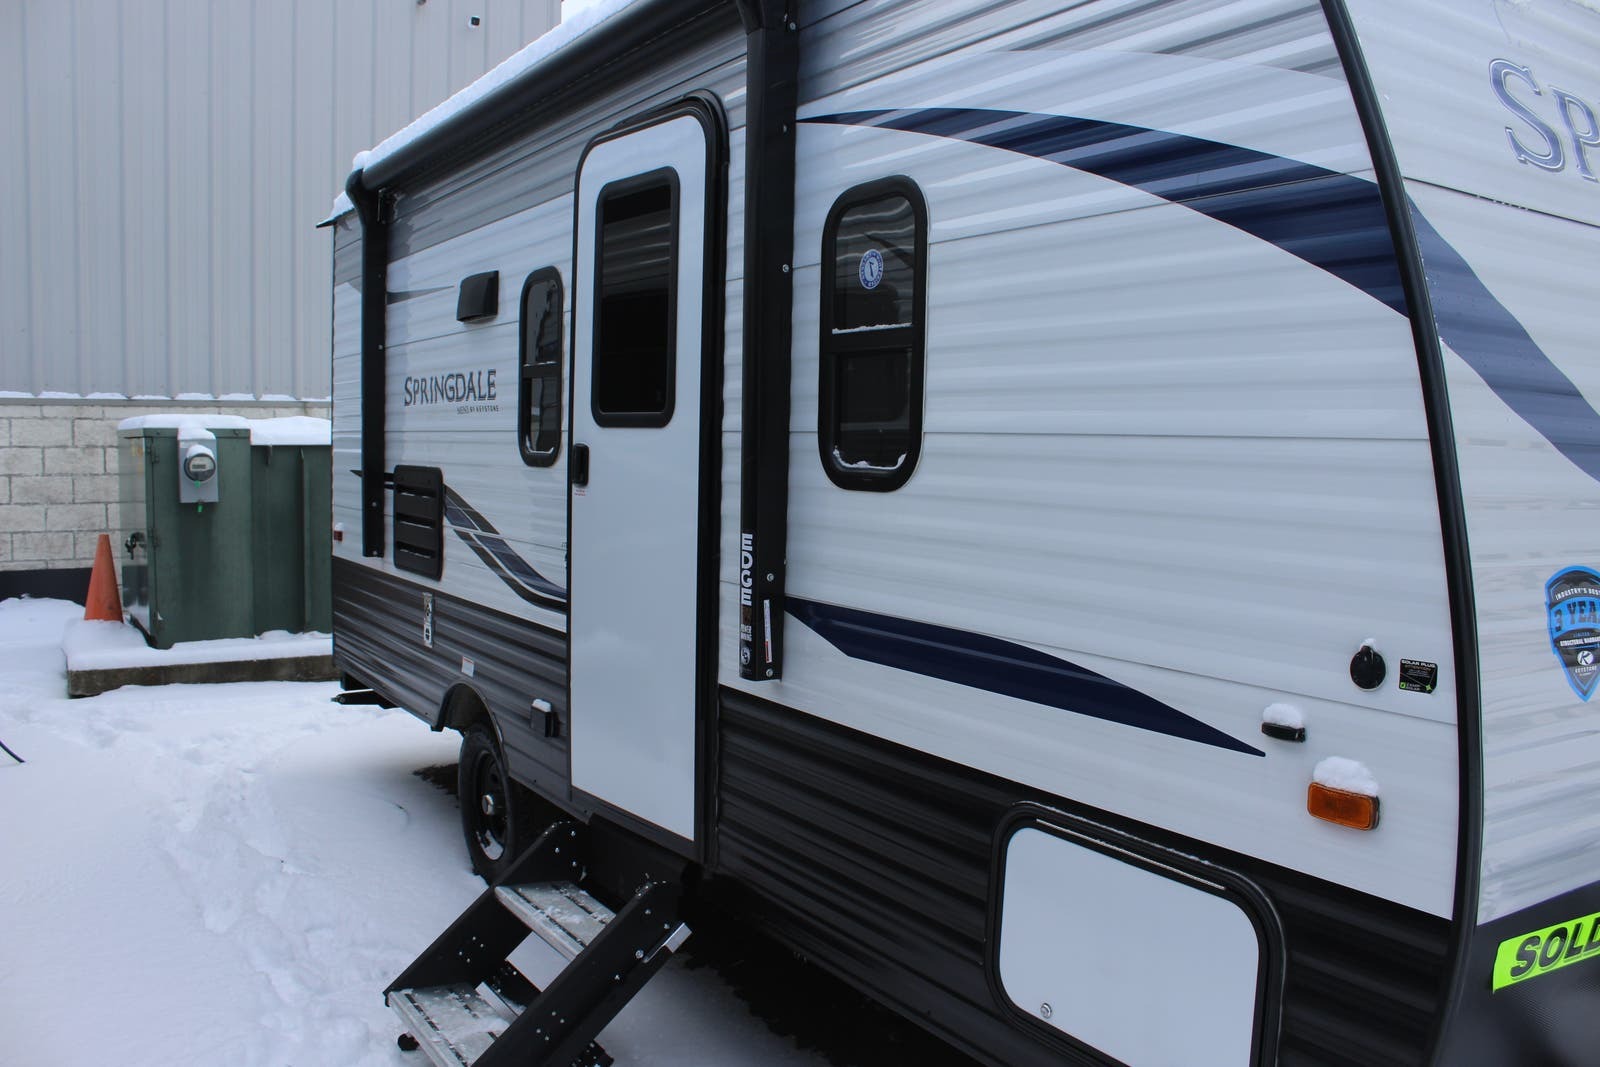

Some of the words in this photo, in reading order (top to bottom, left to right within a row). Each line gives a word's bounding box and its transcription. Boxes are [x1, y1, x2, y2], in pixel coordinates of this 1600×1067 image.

[403, 368, 497, 407] SPRINGDALE
[741, 532, 753, 607] EDGE
[1555, 587, 1588, 600] INDUSTRY'S
[1554, 609, 1563, 632] 3
[1566, 600, 1600, 624] YEA
[1401, 659, 1420, 667] SOLAR
[1574, 665, 1597, 674] KEYSTONE
[1510, 915, 1600, 979] SOLD
